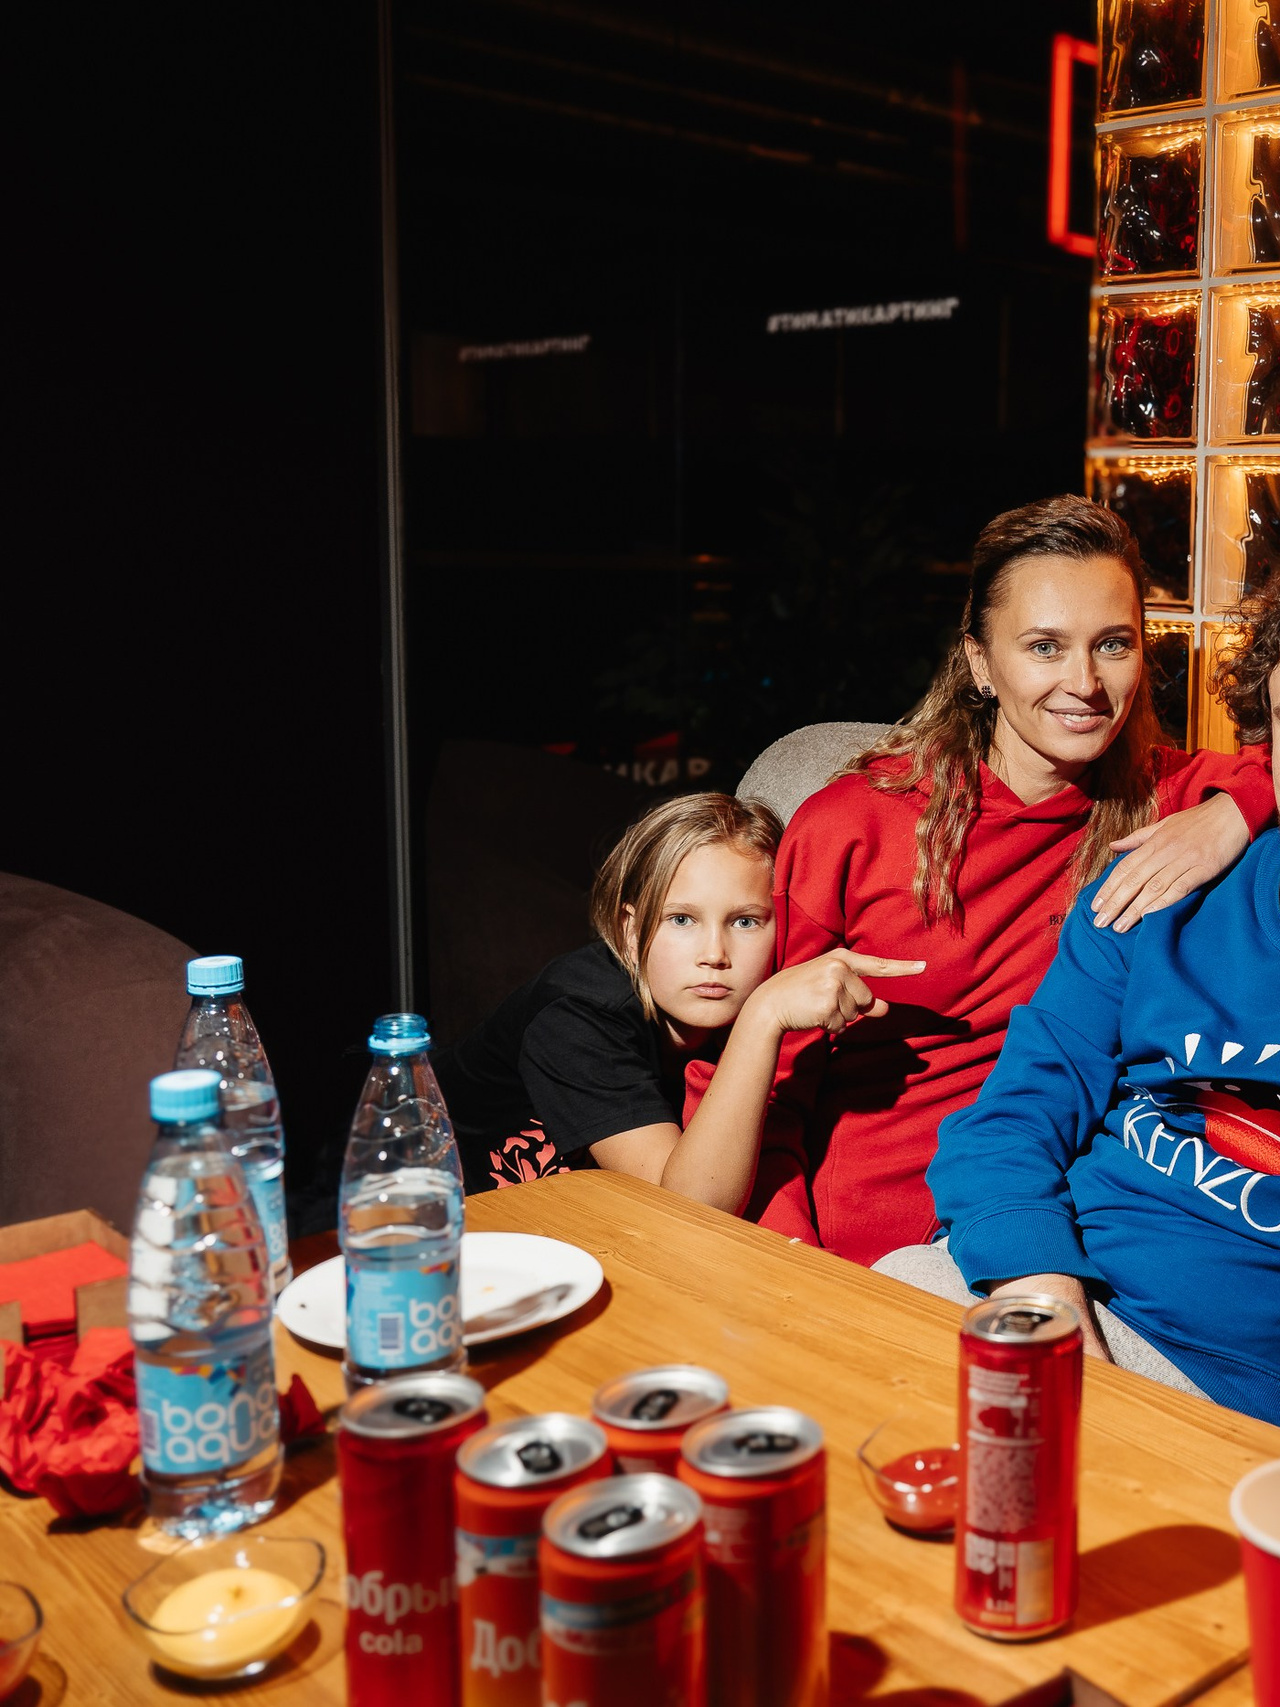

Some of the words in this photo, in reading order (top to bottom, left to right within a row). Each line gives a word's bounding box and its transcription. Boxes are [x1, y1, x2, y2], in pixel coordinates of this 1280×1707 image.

[1049, 914, 1066, 926] BO
[409, 1294, 458, 1330] bo
[410, 1321, 459, 1355] aq
[161, 1382, 274, 1435] bona
[165, 1410, 276, 1464] aqua
[345, 1570, 459, 1626] обры
[359, 1629, 423, 1656] cola
